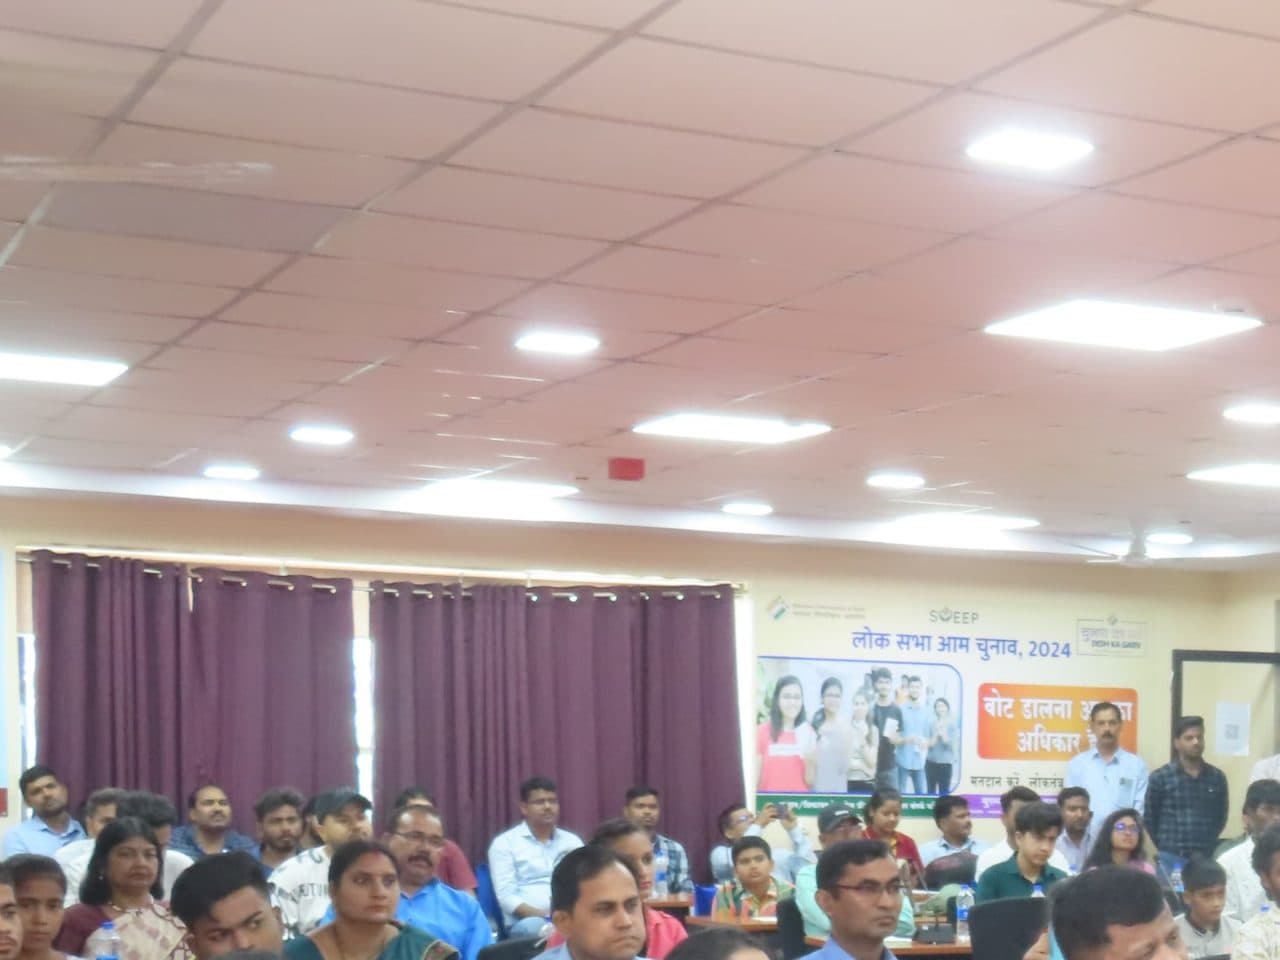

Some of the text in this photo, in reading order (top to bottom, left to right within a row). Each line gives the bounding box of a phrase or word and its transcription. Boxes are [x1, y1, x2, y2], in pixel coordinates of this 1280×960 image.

[852, 626, 1072, 661] लोक सभा आम चुनाव, 2024
[1020, 698, 1072, 720] डालना
[1017, 723, 1081, 752] अधिकार
